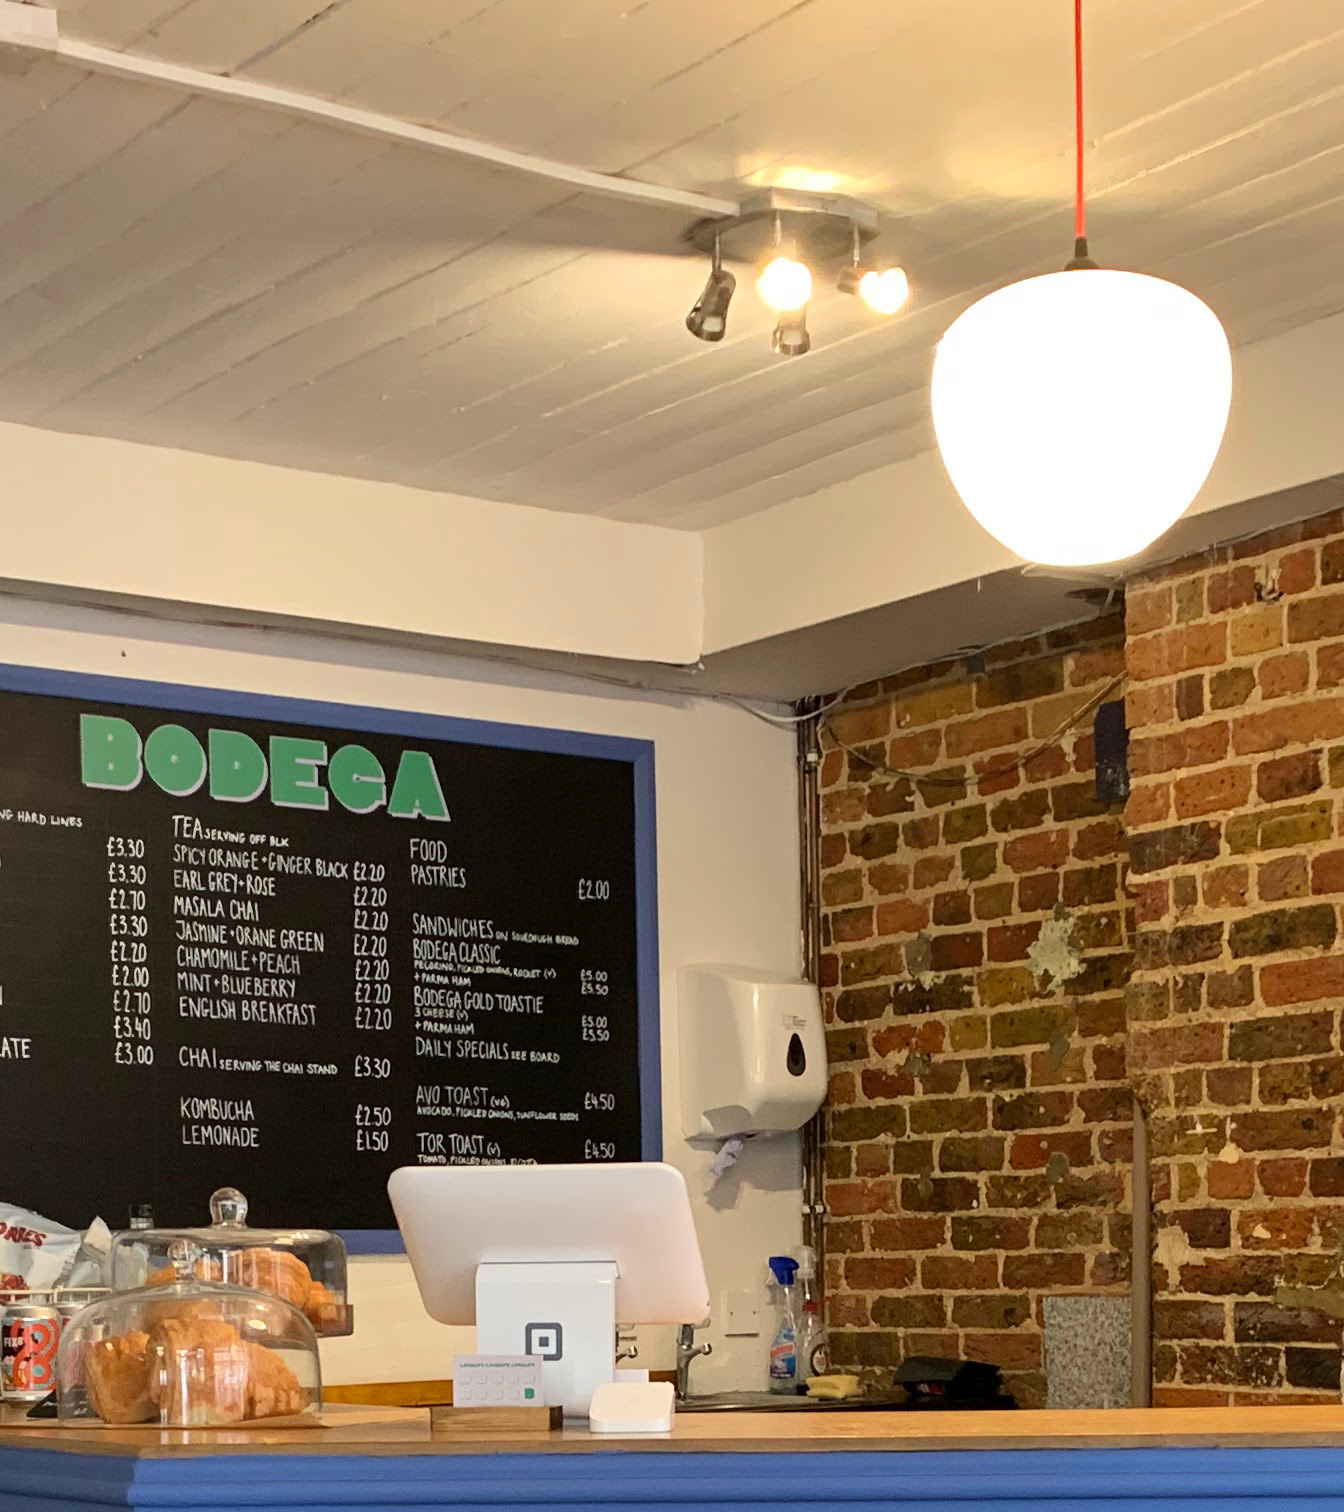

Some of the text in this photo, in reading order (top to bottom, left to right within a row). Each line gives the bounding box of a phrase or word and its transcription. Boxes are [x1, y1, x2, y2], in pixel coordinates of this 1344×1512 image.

[80, 713, 451, 821] BODEGA
[17, 811, 46, 825] HARD
[51, 815, 82, 827] LINES
[172, 815, 289, 847] TEA SERVING OFF BLK
[107, 837, 145, 858] £3.30
[410, 838, 448, 863] FOOD
[108, 863, 146, 885] £3.30
[173, 844, 206, 865] SPICY
[209, 848, 259, 871] ORANGE
[268, 852, 312, 875] GINGER
[316, 858, 349, 879] BLACK
[353, 861, 385, 882] £2.20
[174, 870, 206, 891] EARL
[209, 871, 238, 893] GREY
[247, 874, 276, 896] ROSE
[353, 886, 387, 907] £2.20
[411, 864, 610, 900] PASTRIES £2.00
[108, 888, 146, 911] £2.70
[110, 914, 148, 936] £3.30
[174, 896, 388, 931] MASALA CHAI £2.20
[413, 912, 494, 939] SANDWICHES
[110, 940, 147, 963] £2.20
[175, 920, 228, 944] JASMINE
[236, 926, 276, 948] ORANE
[280, 929, 324, 953] GREEN
[354, 934, 387, 957] £2.20
[413, 938, 501, 965] BODEGA CLASSIC
[111, 965, 149, 987] £2.00
[177, 945, 251, 971] CHAMOMILE
[259, 951, 301, 975] PEACH
[355, 959, 390, 981] £2.20
[513, 968, 542, 978] ROCKET
[581, 969, 608, 982] £5.00
[177, 972, 211, 993] MINT
[221, 975, 296, 998] BLUEBERRY
[355, 983, 391, 1004] £2.20
[422, 973, 450, 985] PARMA
[452, 976, 471, 987] HAM
[581, 982, 608, 996] £5.50
[113, 990, 151, 1014] £2.70
[414, 985, 544, 1014] BODEGA GOLD TOASTIE
[179, 996, 392, 1030] ENGLISH BREAKFAST £2.20
[415, 1008, 421, 1018] 3
[423, 1009, 455, 1019] CHEESE
[581, 1015, 608, 1028] £5.00
[113, 1015, 151, 1040] £3.40
[582, 1029, 610, 1042] £5.50
[115, 1042, 154, 1065] £3.00
[179, 1046, 390, 1078] CHAI SERVING THE CHAI STAND £3.30
[415, 1036, 560, 1063] DAILY SPECIALS SEE BOARD
[416, 1085, 440, 1105] AVO
[445, 1086, 489, 1107] TOAST
[584, 1092, 615, 1111] £4.50
[180, 1097, 391, 1127] KOMBUCHA £2.50
[182, 1125, 389, 1151] LEMONADE £1.50
[416, 1132, 446, 1154] TOR
[449, 1134, 485, 1155] TOAST
[584, 1139, 615, 1160] £4.50
